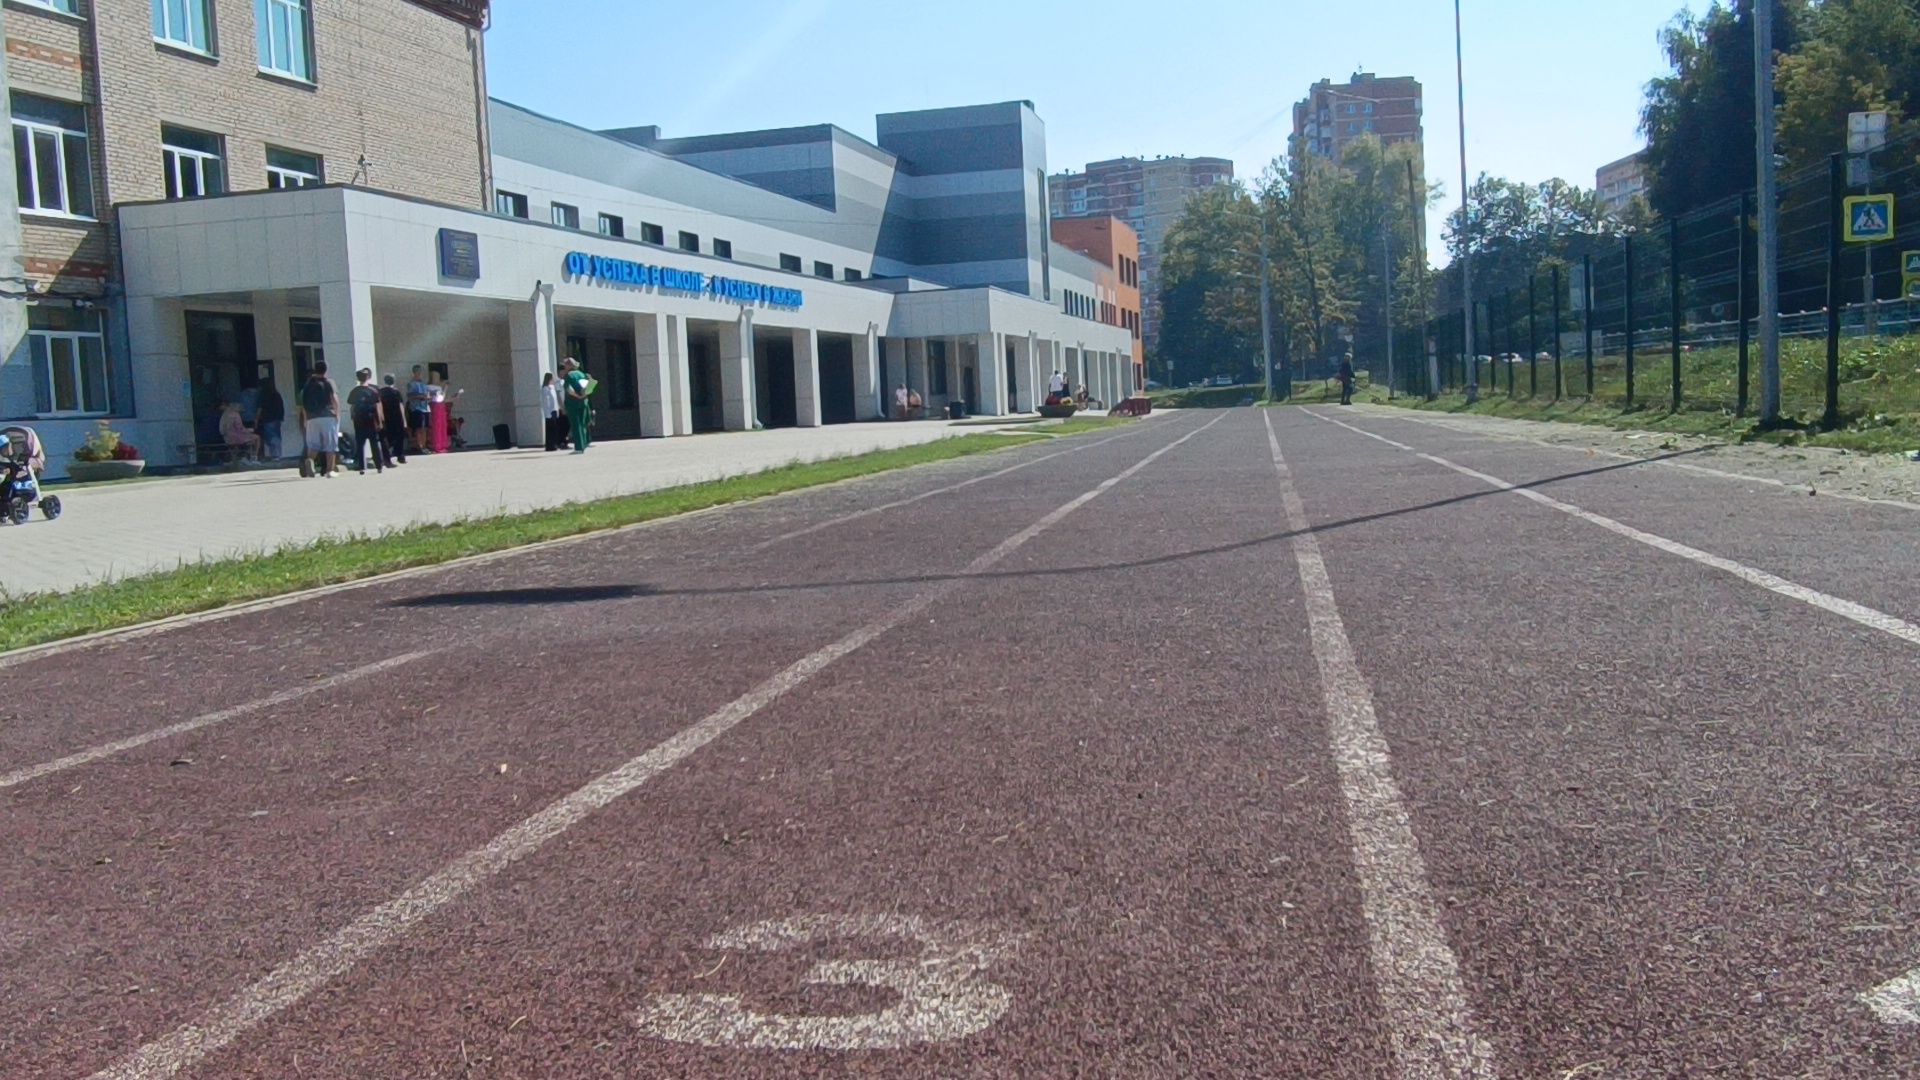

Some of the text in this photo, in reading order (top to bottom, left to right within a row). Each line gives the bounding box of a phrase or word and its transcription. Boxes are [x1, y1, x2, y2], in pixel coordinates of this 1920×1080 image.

[566, 250, 591, 276] ОТ
[593, 254, 650, 284] УСПЕХА
[651, 265, 661, 284] В
[662, 267, 705, 292] ШКОЛЕ
[762, 284, 771, 303] В
